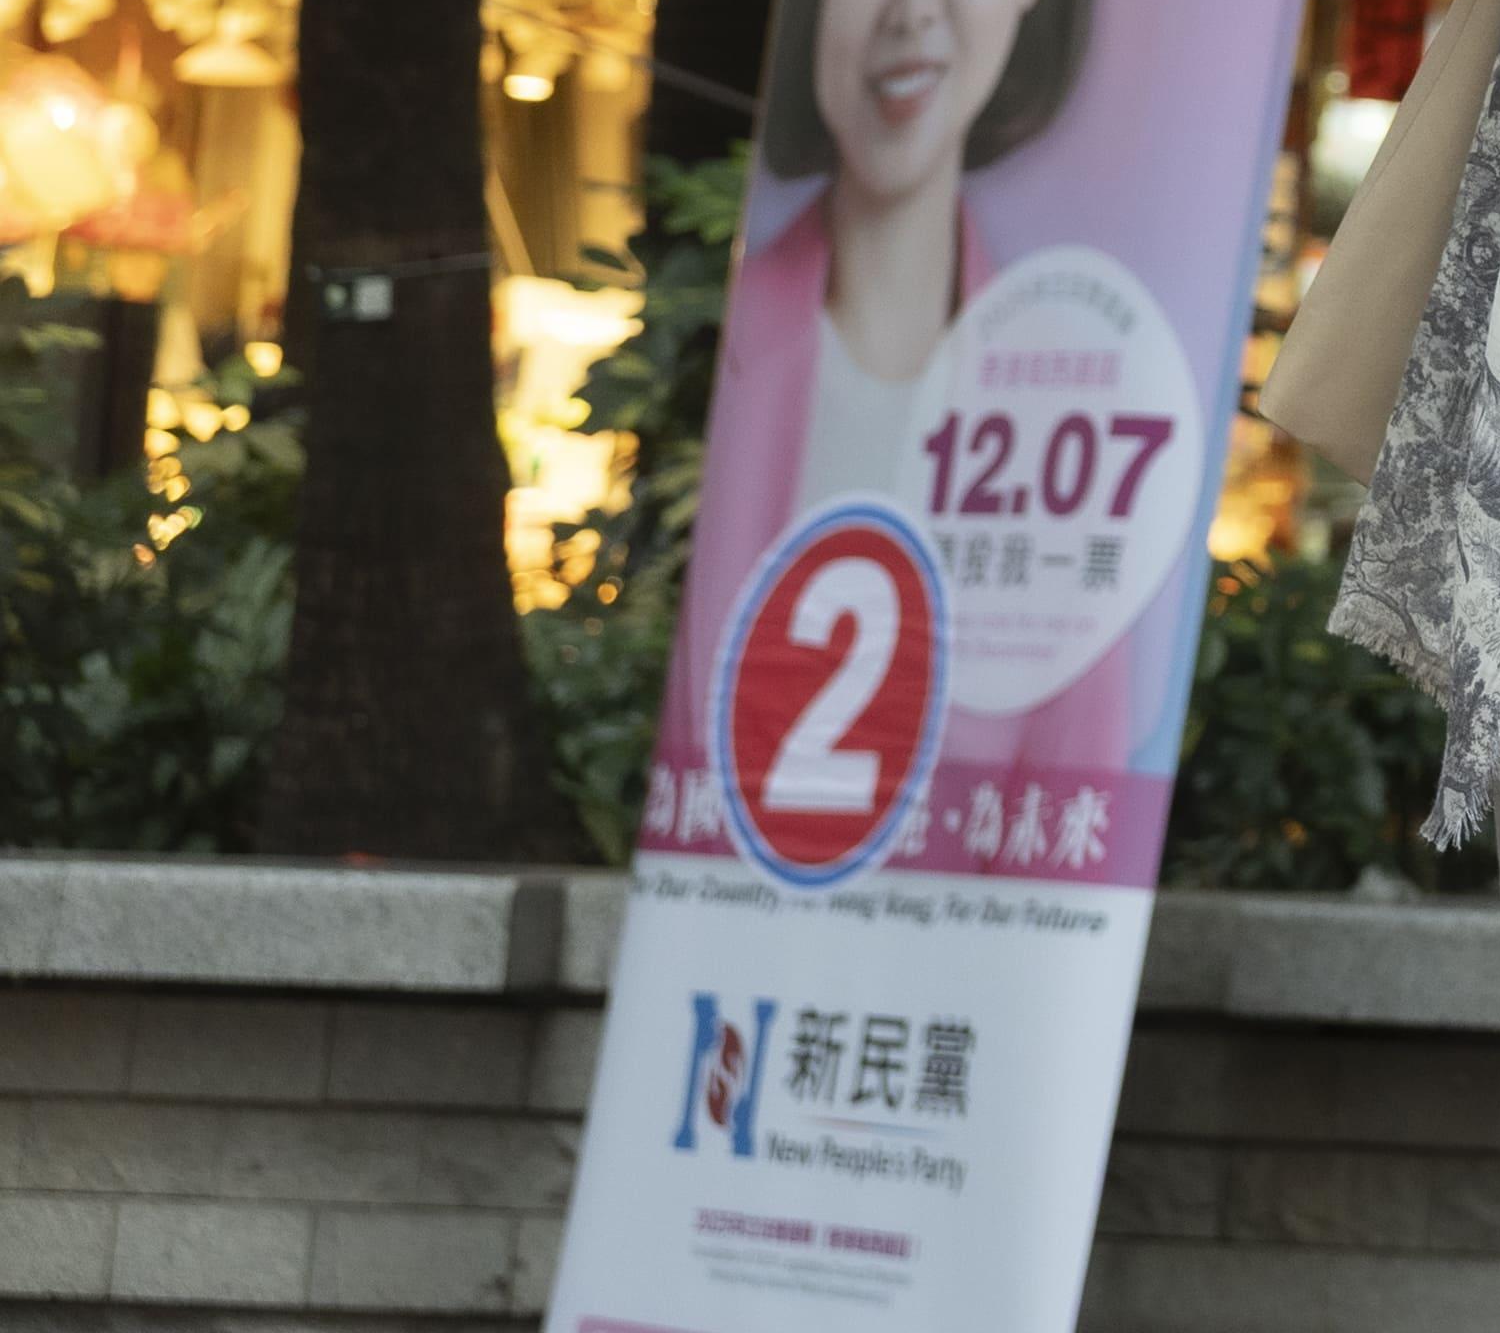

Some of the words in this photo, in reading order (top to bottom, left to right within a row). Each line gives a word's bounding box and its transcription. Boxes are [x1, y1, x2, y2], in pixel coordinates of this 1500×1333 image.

[923, 409, 1178, 521] 12.07
[760, 554, 903, 813] 2
[785, 1004, 977, 1120] 新民黨
[767, 1132, 811, 1168] New
[911, 1145, 968, 1199] Party
